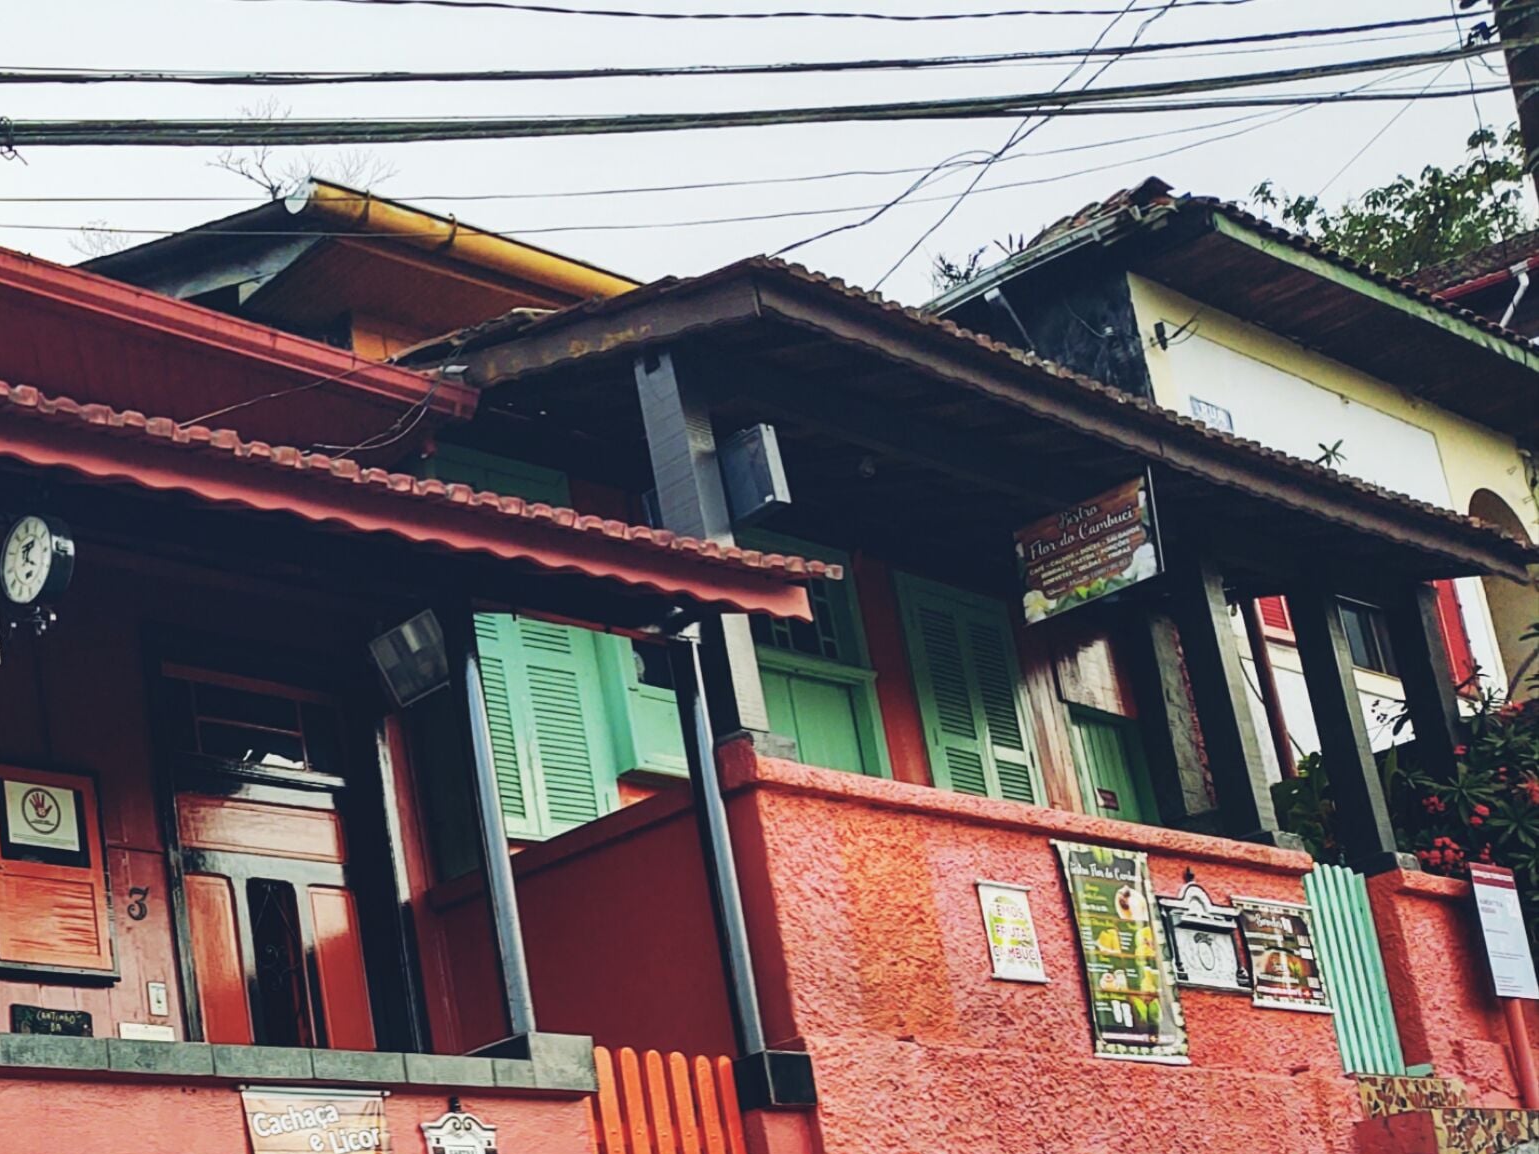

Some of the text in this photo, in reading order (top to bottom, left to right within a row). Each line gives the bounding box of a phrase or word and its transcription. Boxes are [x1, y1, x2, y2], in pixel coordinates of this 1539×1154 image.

[1029, 505, 1133, 560] Flor do Cambuci
[1059, 505, 1098, 528] Bistro
[127, 886, 150, 921] 3
[252, 1104, 339, 1137] Cachaça
[309, 1127, 380, 1154] e Licor
